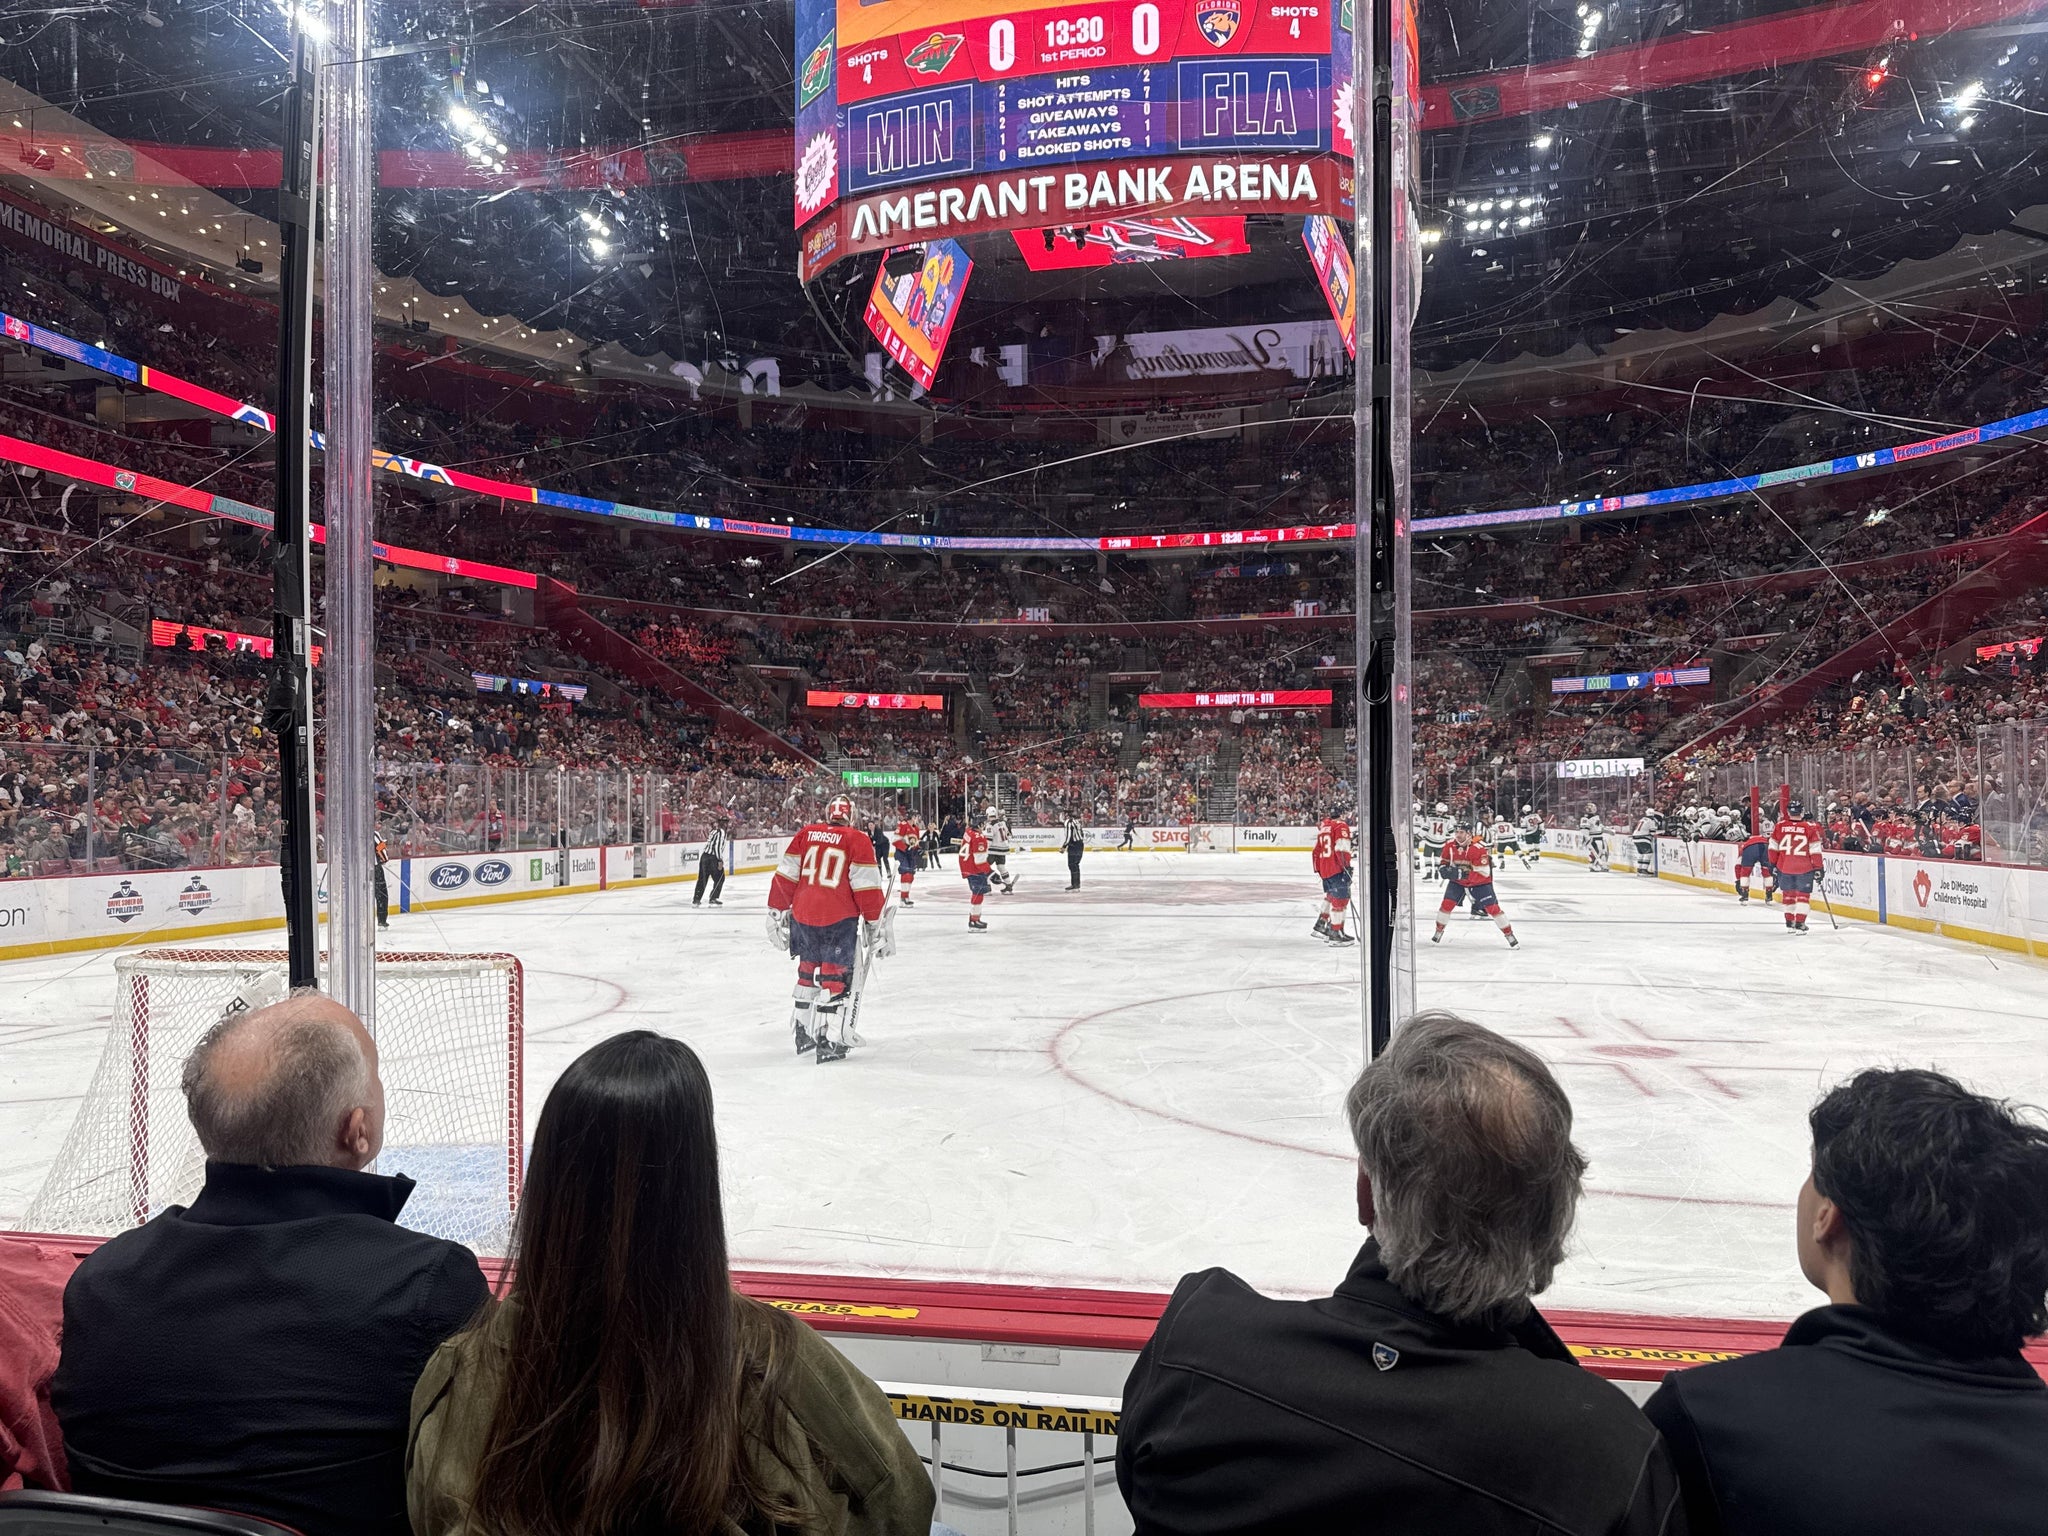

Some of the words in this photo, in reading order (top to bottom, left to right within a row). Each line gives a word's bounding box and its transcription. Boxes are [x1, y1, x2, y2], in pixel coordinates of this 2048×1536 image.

[1271, 7, 1319, 17] SHOTS
[1045, 15, 1104, 47] 13:30
[1132, 3, 1160, 56] 0
[1289, 18, 1301, 39] 4
[989, 19, 1015, 71] 0
[848, 50, 888, 67] SHOTS
[1040, 52, 1058, 63] 1st
[1060, 46, 1106, 61] PERIOD
[862, 65, 873, 85] 4
[998, 85, 1006, 97] 2
[1056, 75, 1091, 89] HITS
[1143, 69, 1151, 82] 2
[1018, 96, 1054, 109] SHOT
[1056, 88, 1131, 105] ATTEMPTS
[1143, 86, 1151, 98] 7
[1202, 71, 1297, 136] FLA
[999, 117, 1006, 129] 2
[1030, 105, 1118, 124] GIVEAWAYS
[1143, 104, 1151, 116] 0
[867, 99, 953, 176] MIN
[1000, 133, 1005, 145] 1
[1028, 122, 1121, 140] TAKEAWAYS
[1145, 119, 1150, 131] 1
[1000, 149, 1006, 162] 0
[1018, 141, 1081, 158] BLOCKED
[1084, 137, 1131, 151] SHOTS
[1145, 135, 1150, 147] 1
[851, 175, 1057, 241] AMERANT
[1064, 166, 1173, 210] BANK
[1183, 164, 1318, 201] ARENA
[0, 203, 93, 264] MEMORIAL
[96, 249, 147, 289] PRESS
[151, 275, 181, 304] BOX
[1856, 454, 1876, 468] VS
[694, 516, 711, 529] VS
[1587, 677, 1611, 690] MIN
[1626, 675, 1639, 687] VS
[1654, 672, 1674, 685] FLA
[868, 695, 880, 706] VS
[1215, 693, 1241, 705] AUGUST
[1241, 693, 1255, 704] 7TH
[863, 775, 887, 785] Baptist
[888, 776, 912, 784] Health
[1152, 830, 1212, 843] SEATGK
[1243, 829, 1278, 843] finally
[1432, 822, 1444, 835] 14
[807, 831, 843, 845] TARASOV
[1778, 834, 1808, 857] 42
[624, 847, 656, 862] AMANT
[481, 863, 505, 882] Ford
[572, 858, 596, 873] Health
[801, 845, 847, 889] 40
[1823, 858, 1853, 877] OMCAST
[437, 867, 463, 886] Ford
[1940, 880, 1950, 890] Joe
[1951, 881, 1979, 894] DiMaggio
[107, 900, 121, 908] DRIVE
[121, 899, 136, 907] SOBER
[1933, 891, 1962, 905] Children's
[1962, 895, 1988, 909] Hospital
[115, 906, 133, 914] PULLED
[776, 1303, 853, 1313] GLASS
[1591, 1348, 1632, 1357] DO
[1641, 1350, 1700, 1360] NOT
[902, 1402, 985, 1424] HANDS
[993, 1409, 1028, 1429] ON
[1037, 1413, 1120, 1435] RAILIN
